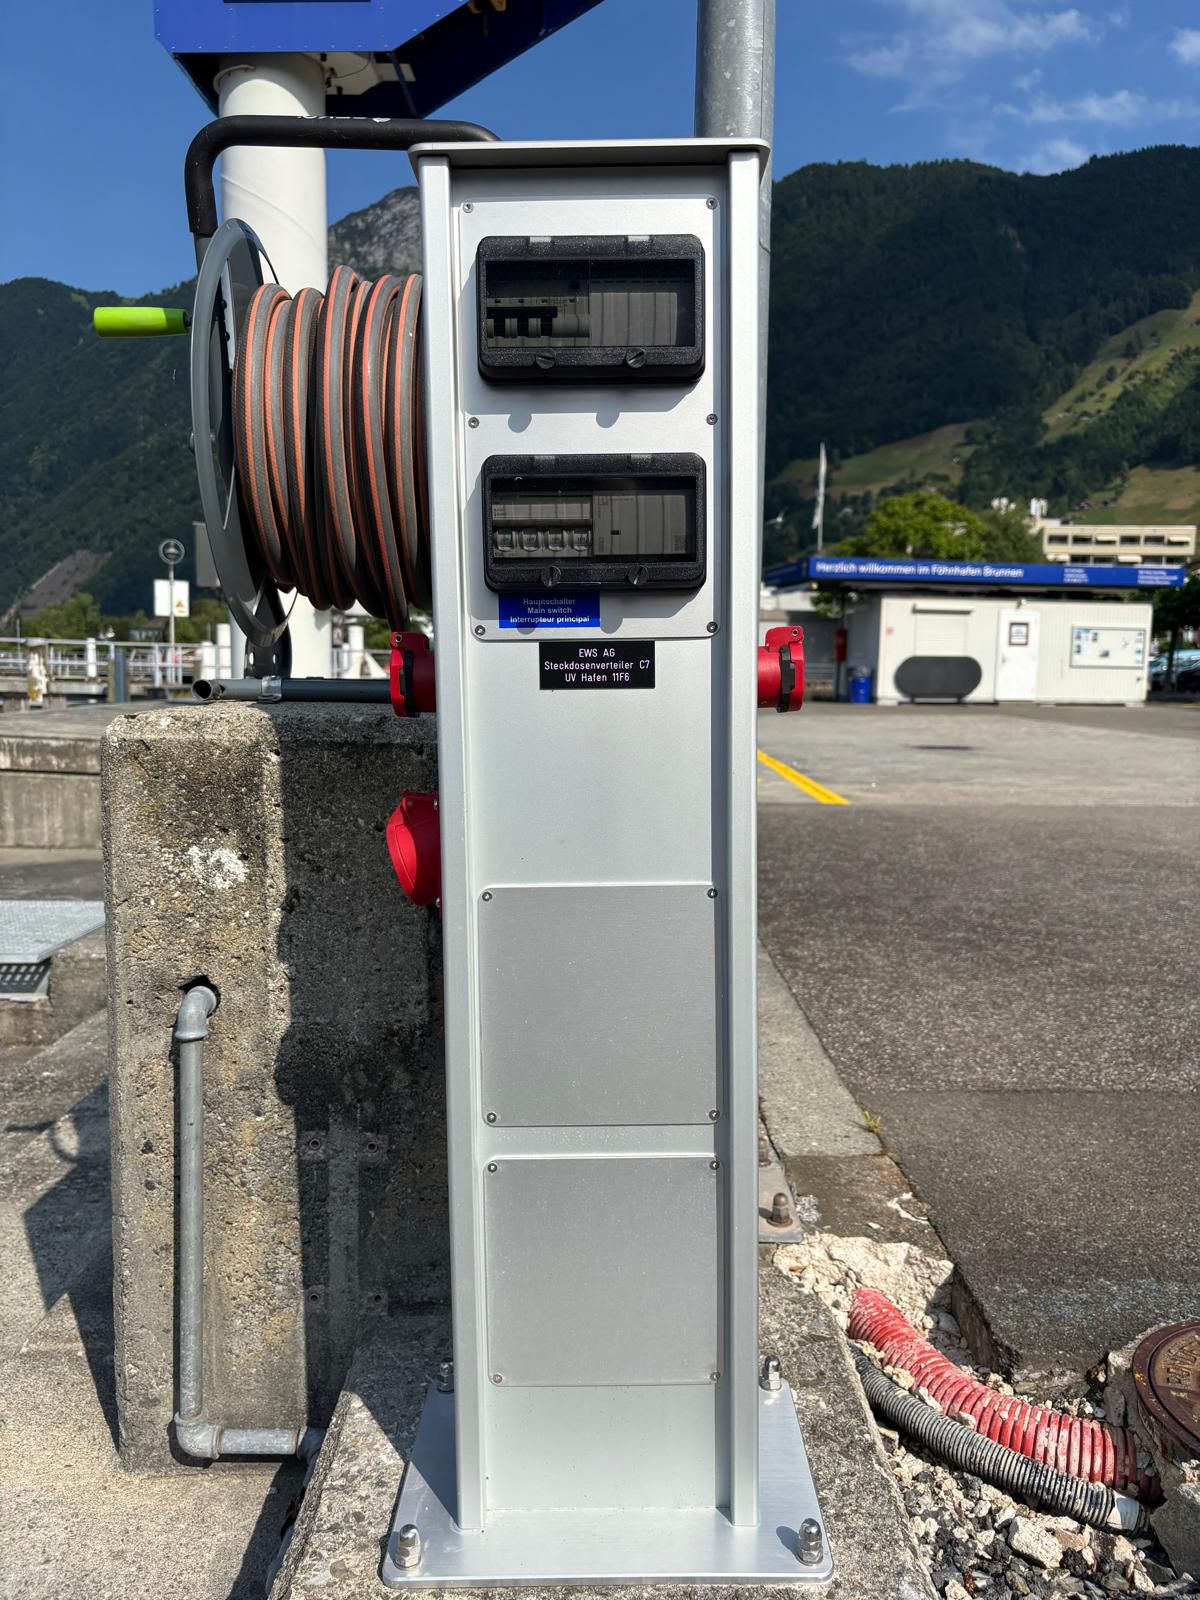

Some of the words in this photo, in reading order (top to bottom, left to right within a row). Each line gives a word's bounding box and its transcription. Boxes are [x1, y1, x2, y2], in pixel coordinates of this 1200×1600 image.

[815, 561, 857, 573] Herzlich
[859, 563, 915, 575] willkommen
[918, 565, 930, 575] im
[983, 566, 1024, 577] Brunnen
[523, 598, 576, 606] Hauptschalter
[578, 648, 598, 658] EWS
[603, 648, 616, 657] AG
[544, 660, 634, 670] Steckdosenverteiler
[639, 659, 650, 669] C7
[565, 673, 576, 682] UV
[581, 673, 607, 682] Hafen
[612, 672, 630, 682] 11F6
